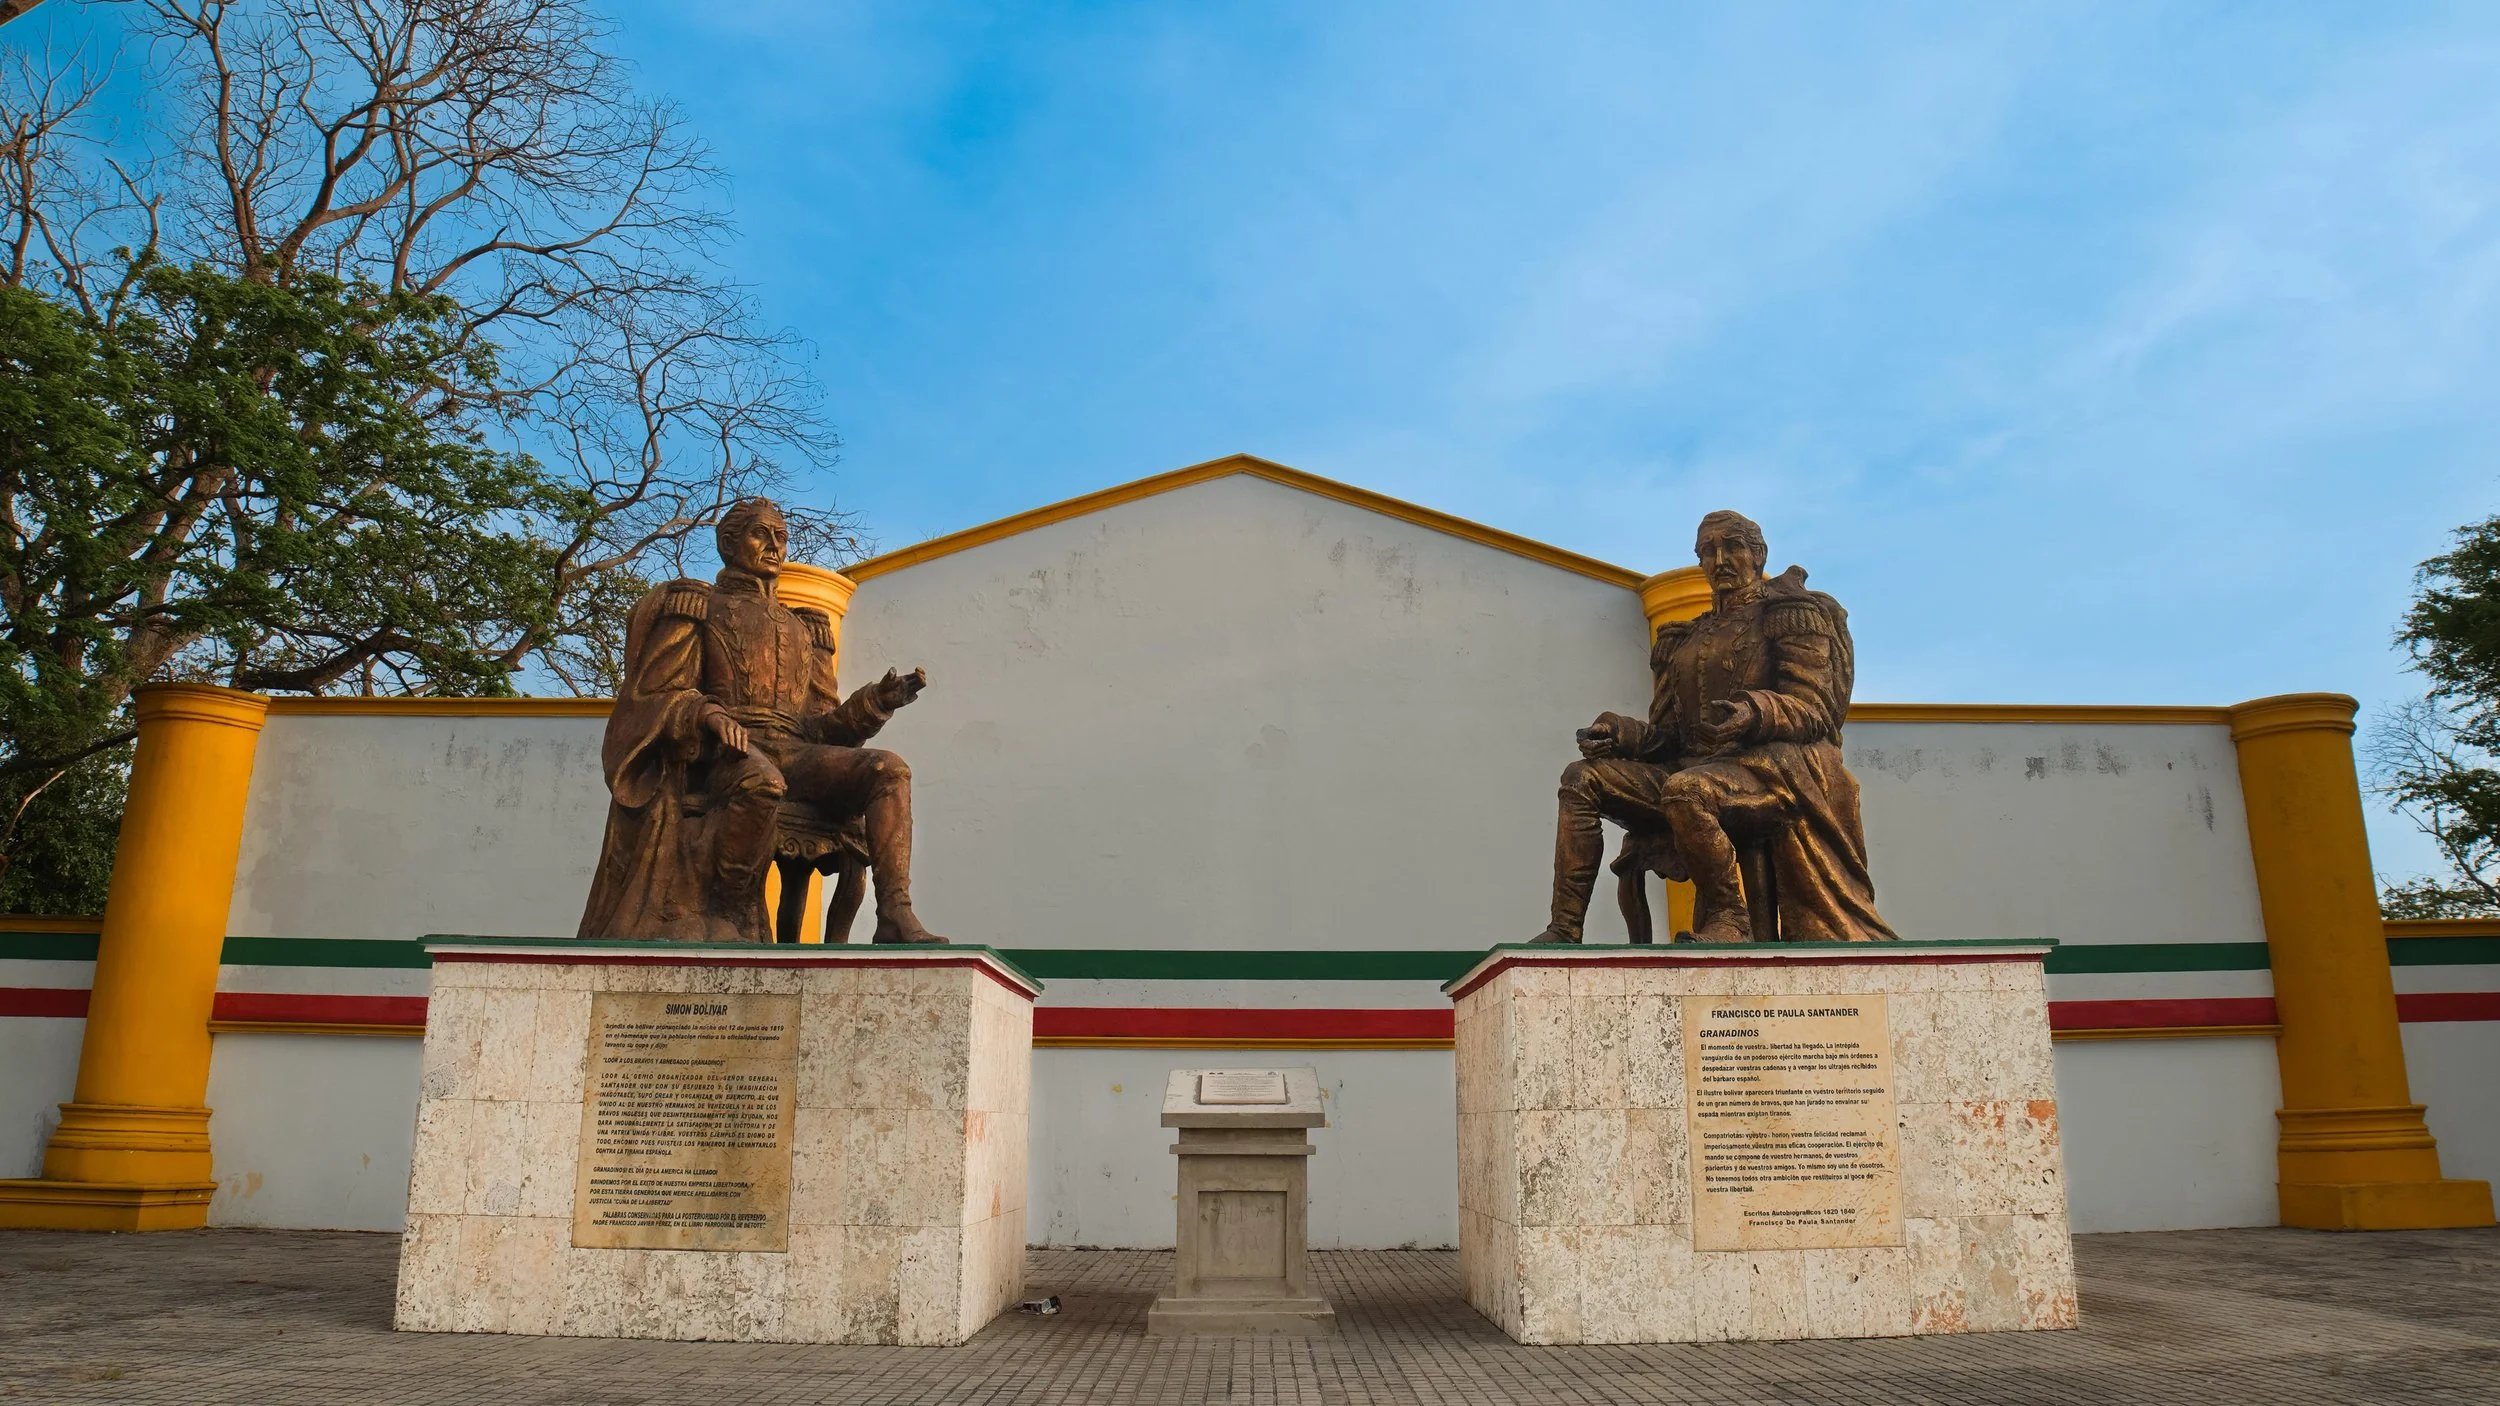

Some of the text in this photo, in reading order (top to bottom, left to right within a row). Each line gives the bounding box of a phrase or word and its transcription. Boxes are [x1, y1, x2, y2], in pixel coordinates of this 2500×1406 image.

[666, 1004, 728, 1015] SIMON BOLIVAR
[1712, 1008, 1859, 1018] FRANCISCO DE PAULA SANTANDER
[1700, 1029, 1759, 1037] GRANADINOS
